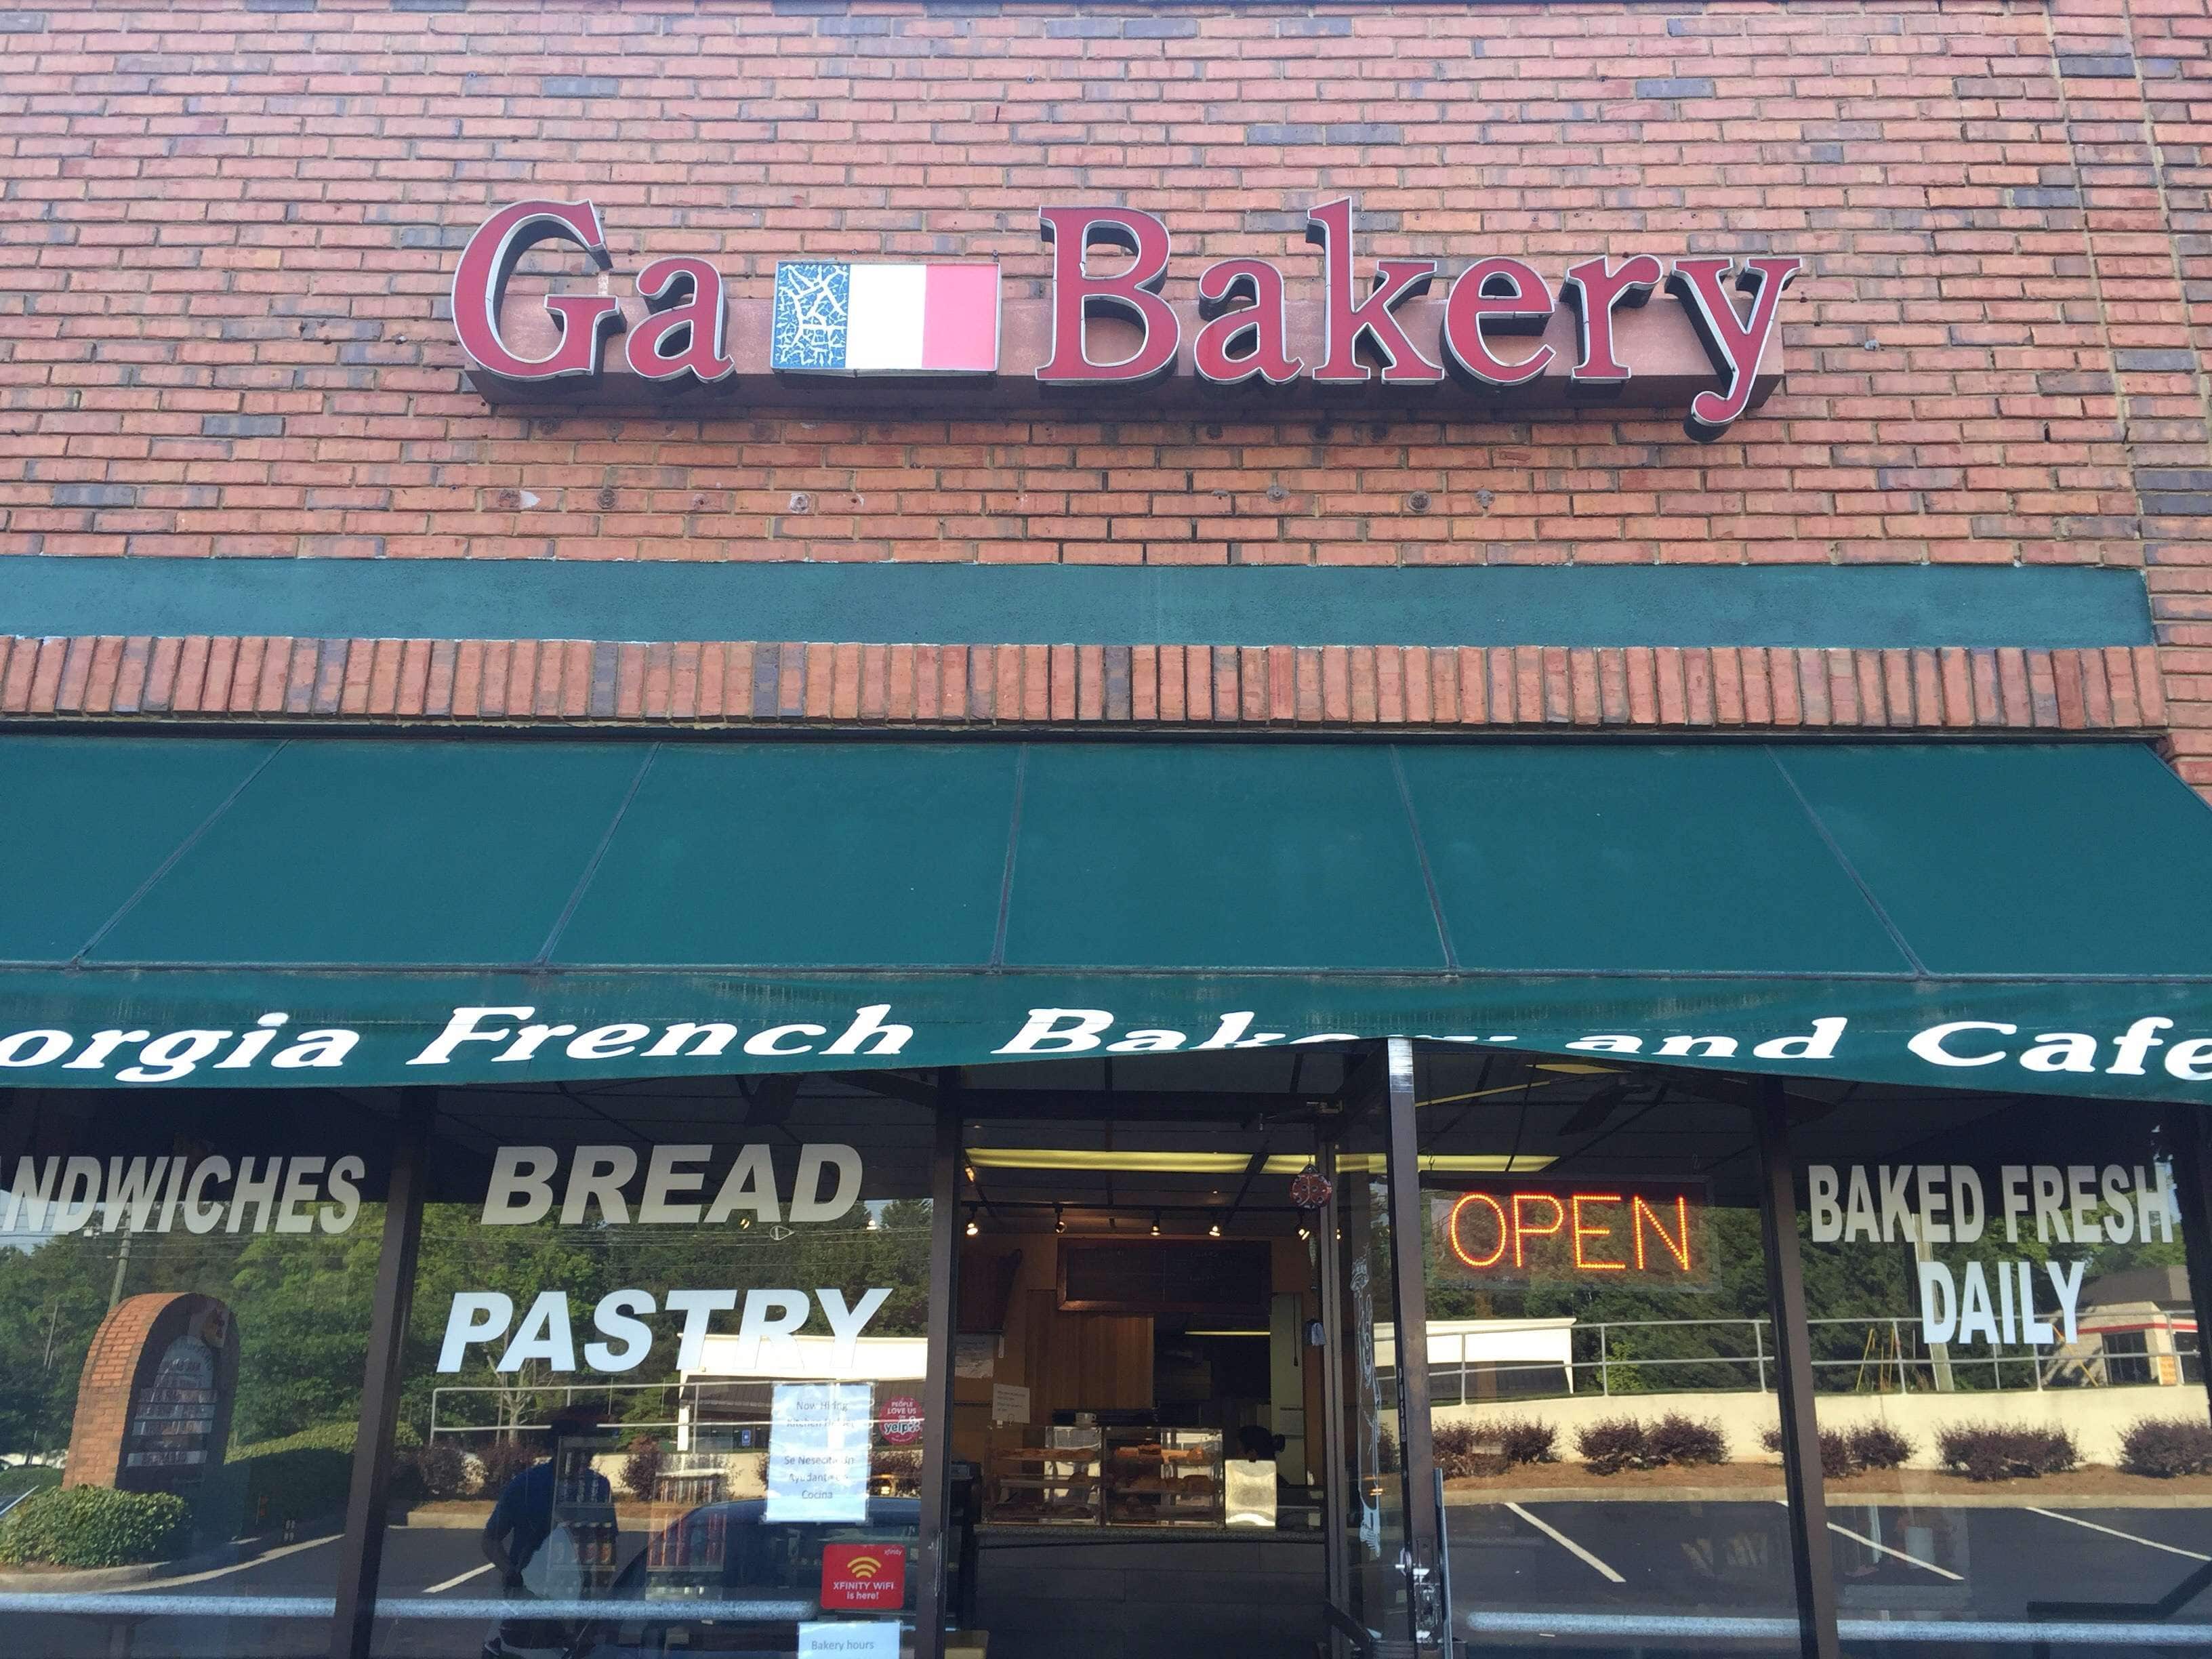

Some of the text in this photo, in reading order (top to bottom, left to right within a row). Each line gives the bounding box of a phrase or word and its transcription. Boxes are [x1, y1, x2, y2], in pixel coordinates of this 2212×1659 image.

[451, 197, 1801, 428] Ga Bakery
[0, 1004, 2212, 1082] orgia French Bak and Cafe
[1, 1155, 365, 1235] NDWICHES
[480, 1143, 863, 1226] BREAD
[1808, 1164, 2173, 1244] BAKED FRESH
[1450, 1193, 1690, 1271] OPEN
[436, 1288, 893, 1373] PASTRY
[1919, 1261, 2085, 1345] DAILY
[798, 1455, 838, 1465] Nesecit
[884, 1420, 909, 1435] yelp
[802, 1490, 833, 1499] Cocina
[834, 1582, 871, 1590] XFINITY
[846, 1591, 879, 1599] is here!
[811, 1639, 874, 1652] Bakery hours
